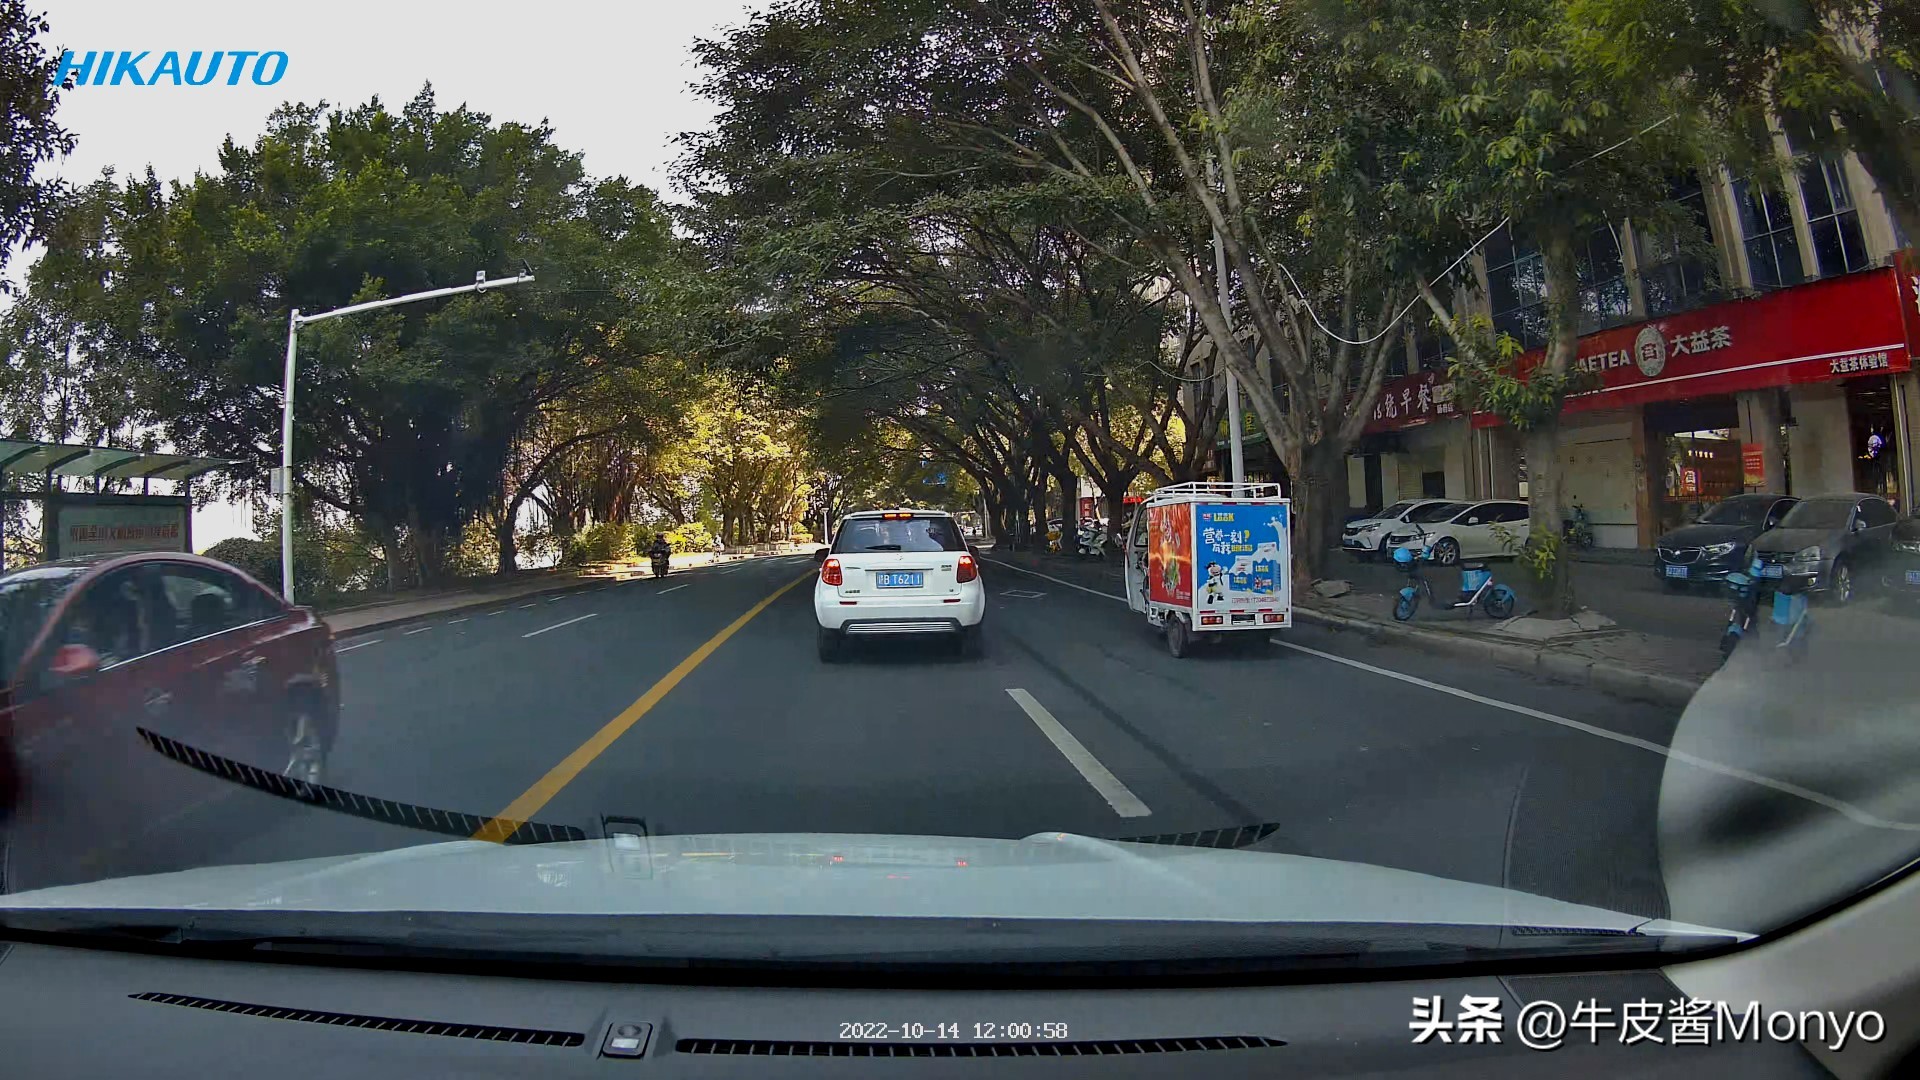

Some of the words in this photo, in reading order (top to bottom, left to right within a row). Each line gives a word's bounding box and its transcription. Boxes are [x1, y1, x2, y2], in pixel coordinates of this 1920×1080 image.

[1670, 325, 1732, 358] 大益茶
[1574, 349, 1631, 374] AETEA
[1829, 351, 1889, 374] 大益茶体验馆
